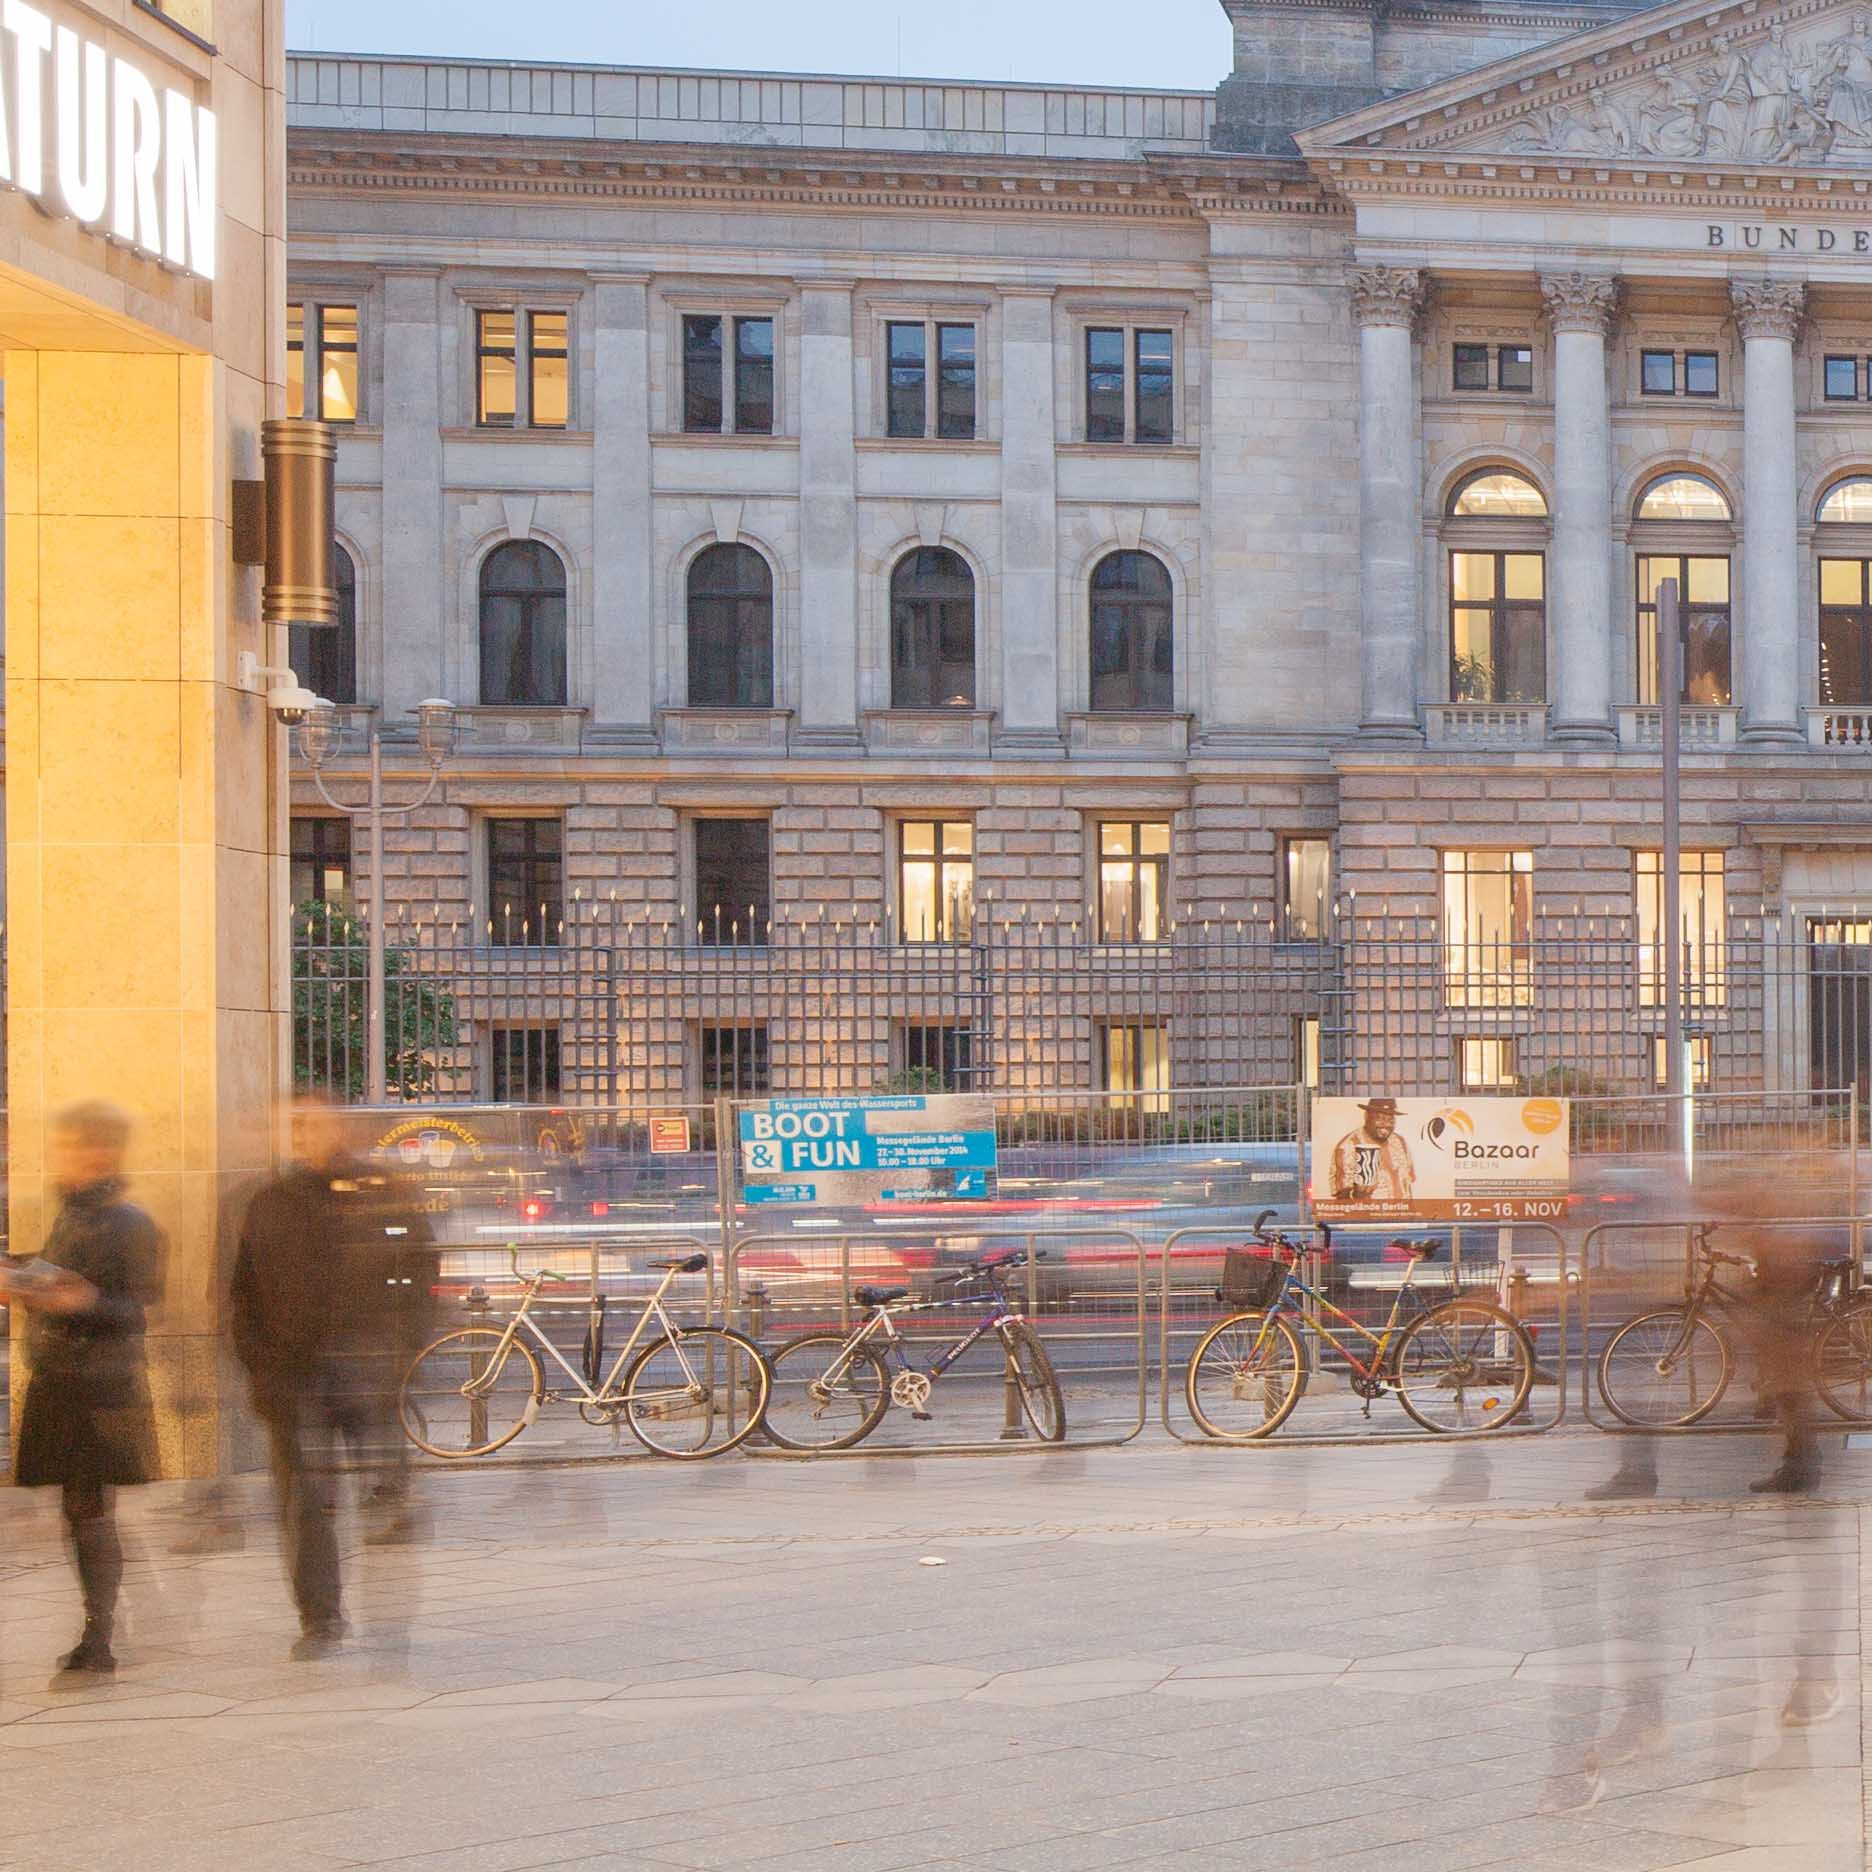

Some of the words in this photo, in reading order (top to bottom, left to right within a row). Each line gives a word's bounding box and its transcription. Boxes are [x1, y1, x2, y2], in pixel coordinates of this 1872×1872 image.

[753, 1111, 850, 1139] BOOT
[751, 1144, 774, 1169] &
[792, 1140, 861, 1167] FUN
[1454, 1140, 1540, 1159] Bazaar
[1524, 1201, 1563, 1217] NOV
